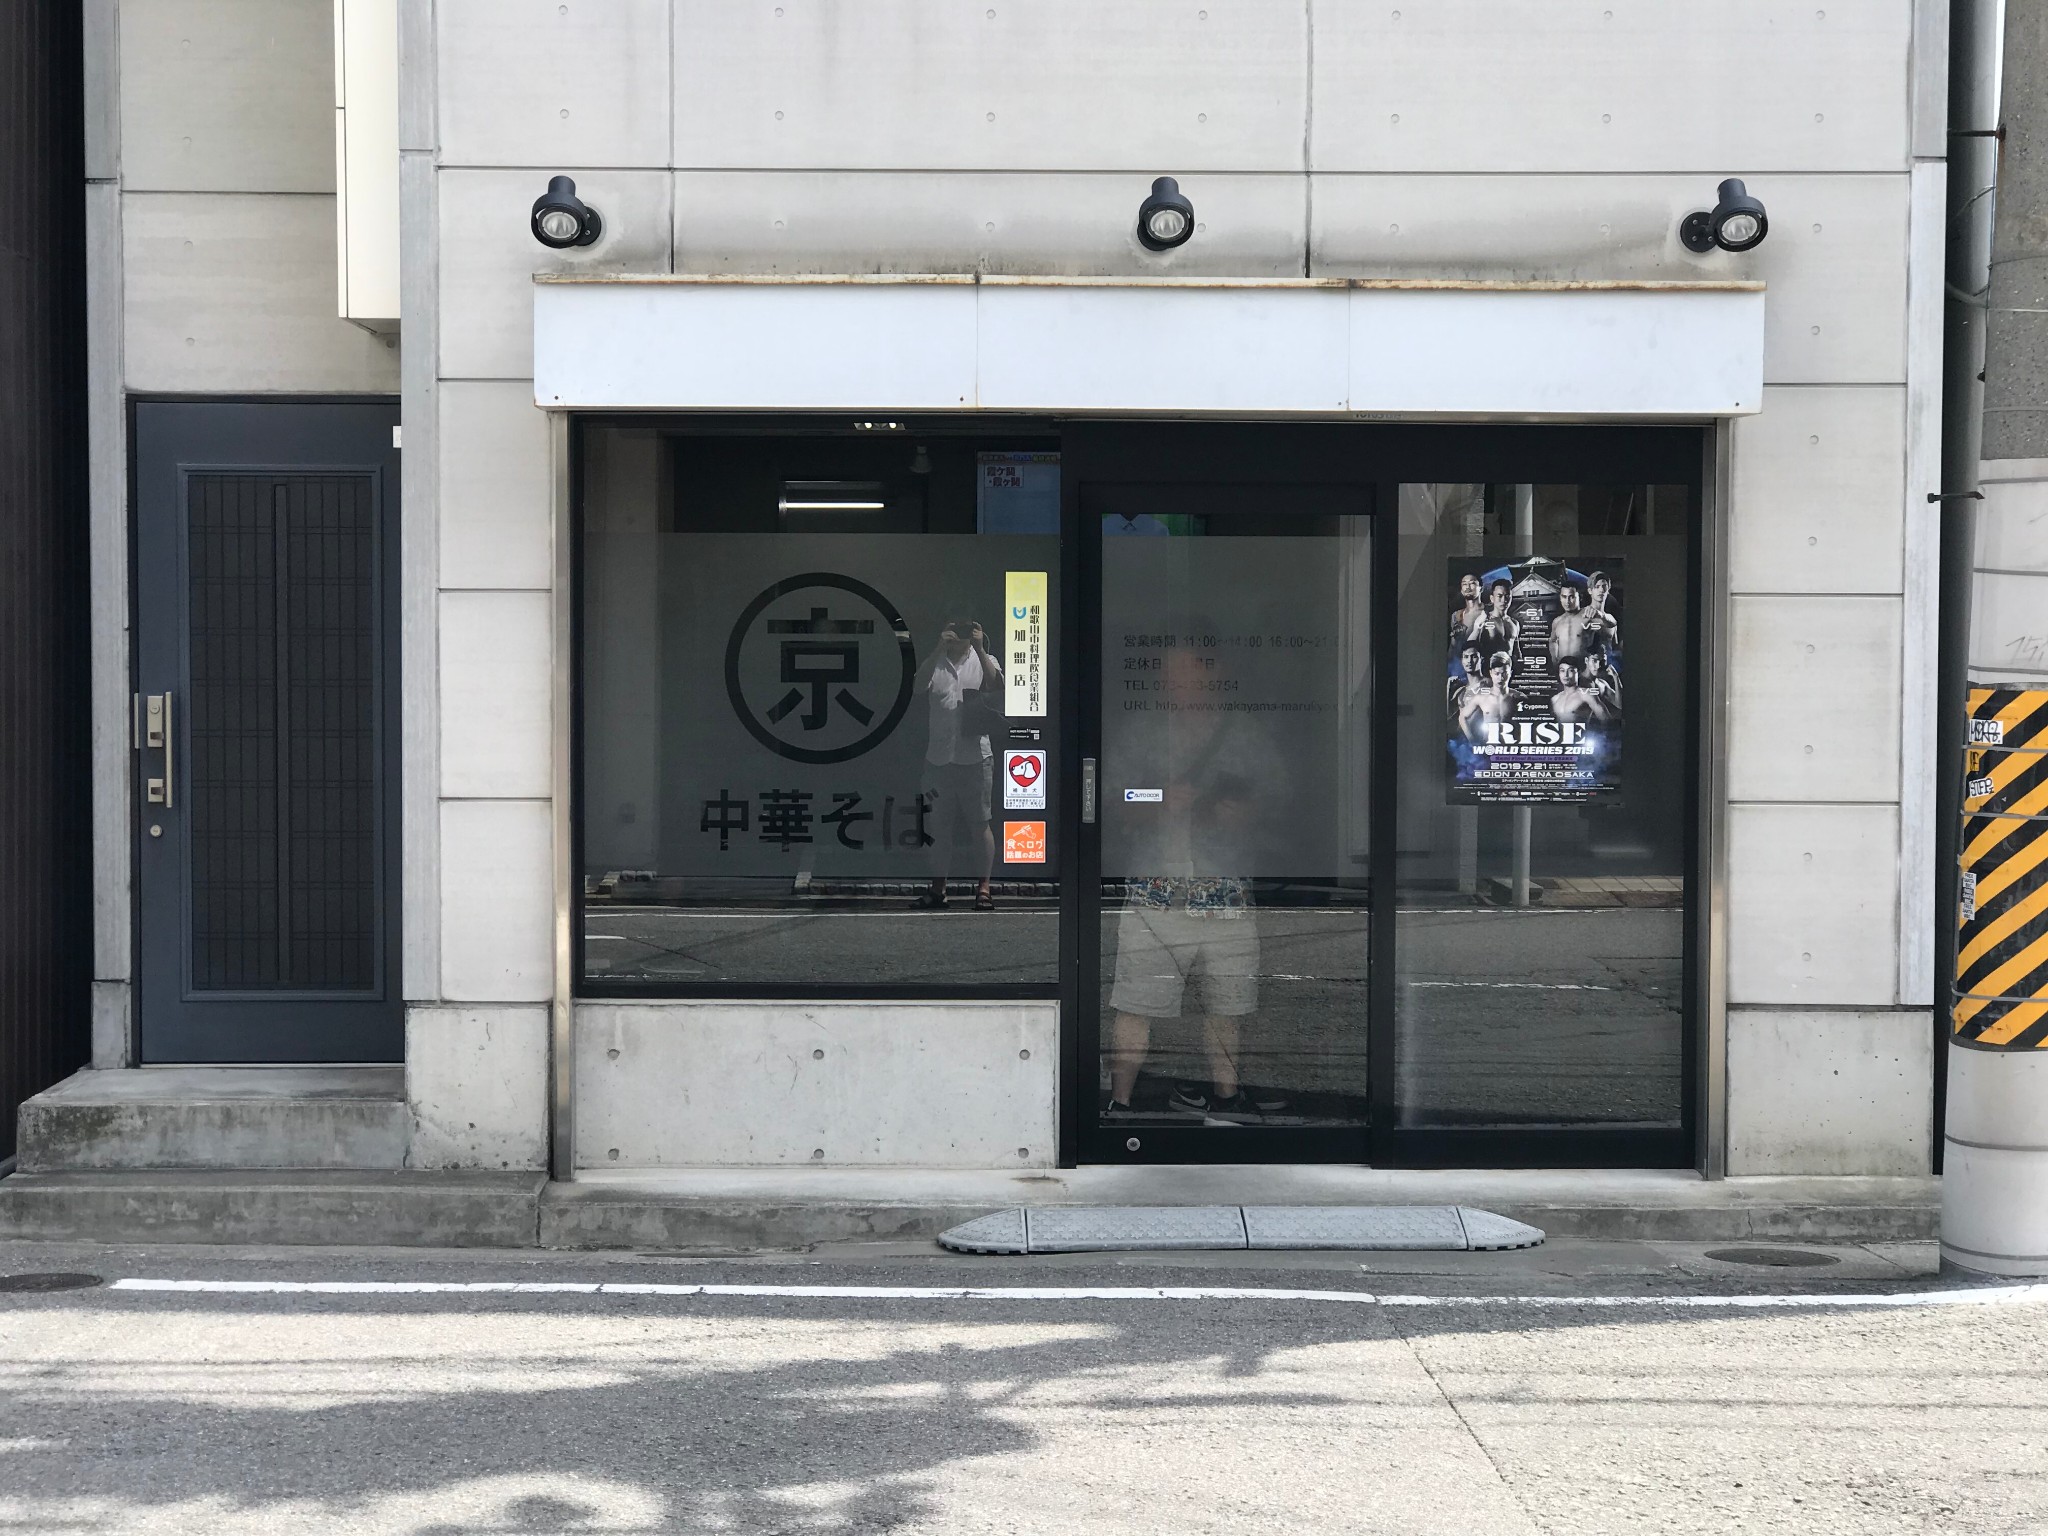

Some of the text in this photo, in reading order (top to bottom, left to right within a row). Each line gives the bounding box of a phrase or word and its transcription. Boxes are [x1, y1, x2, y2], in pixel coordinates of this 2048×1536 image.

[1581, 622, 1602, 631] VS
[1123, 634, 1177, 648] 営業時間
[1014, 629, 1026, 687] 加盟店
[766, 607, 875, 731] 京
[1123, 657, 1162, 671] 定休日
[1123, 680, 1149, 691] TEL
[1470, 687, 1492, 696] VS
[1579, 687, 1601, 696] VS
[1123, 700, 1151, 711] URL
[1524, 703, 1549, 711] Cygames
[1486, 722, 1586, 745] RISE
[1473, 745, 1594, 756] WORLD SERIES 2019
[1490, 762, 1547, 770] 2019.7.21
[700, 788, 940, 852] 中華そば
[1006, 838, 1044, 850] 食べログ
[1006, 850, 1044, 859] 話題のお店
